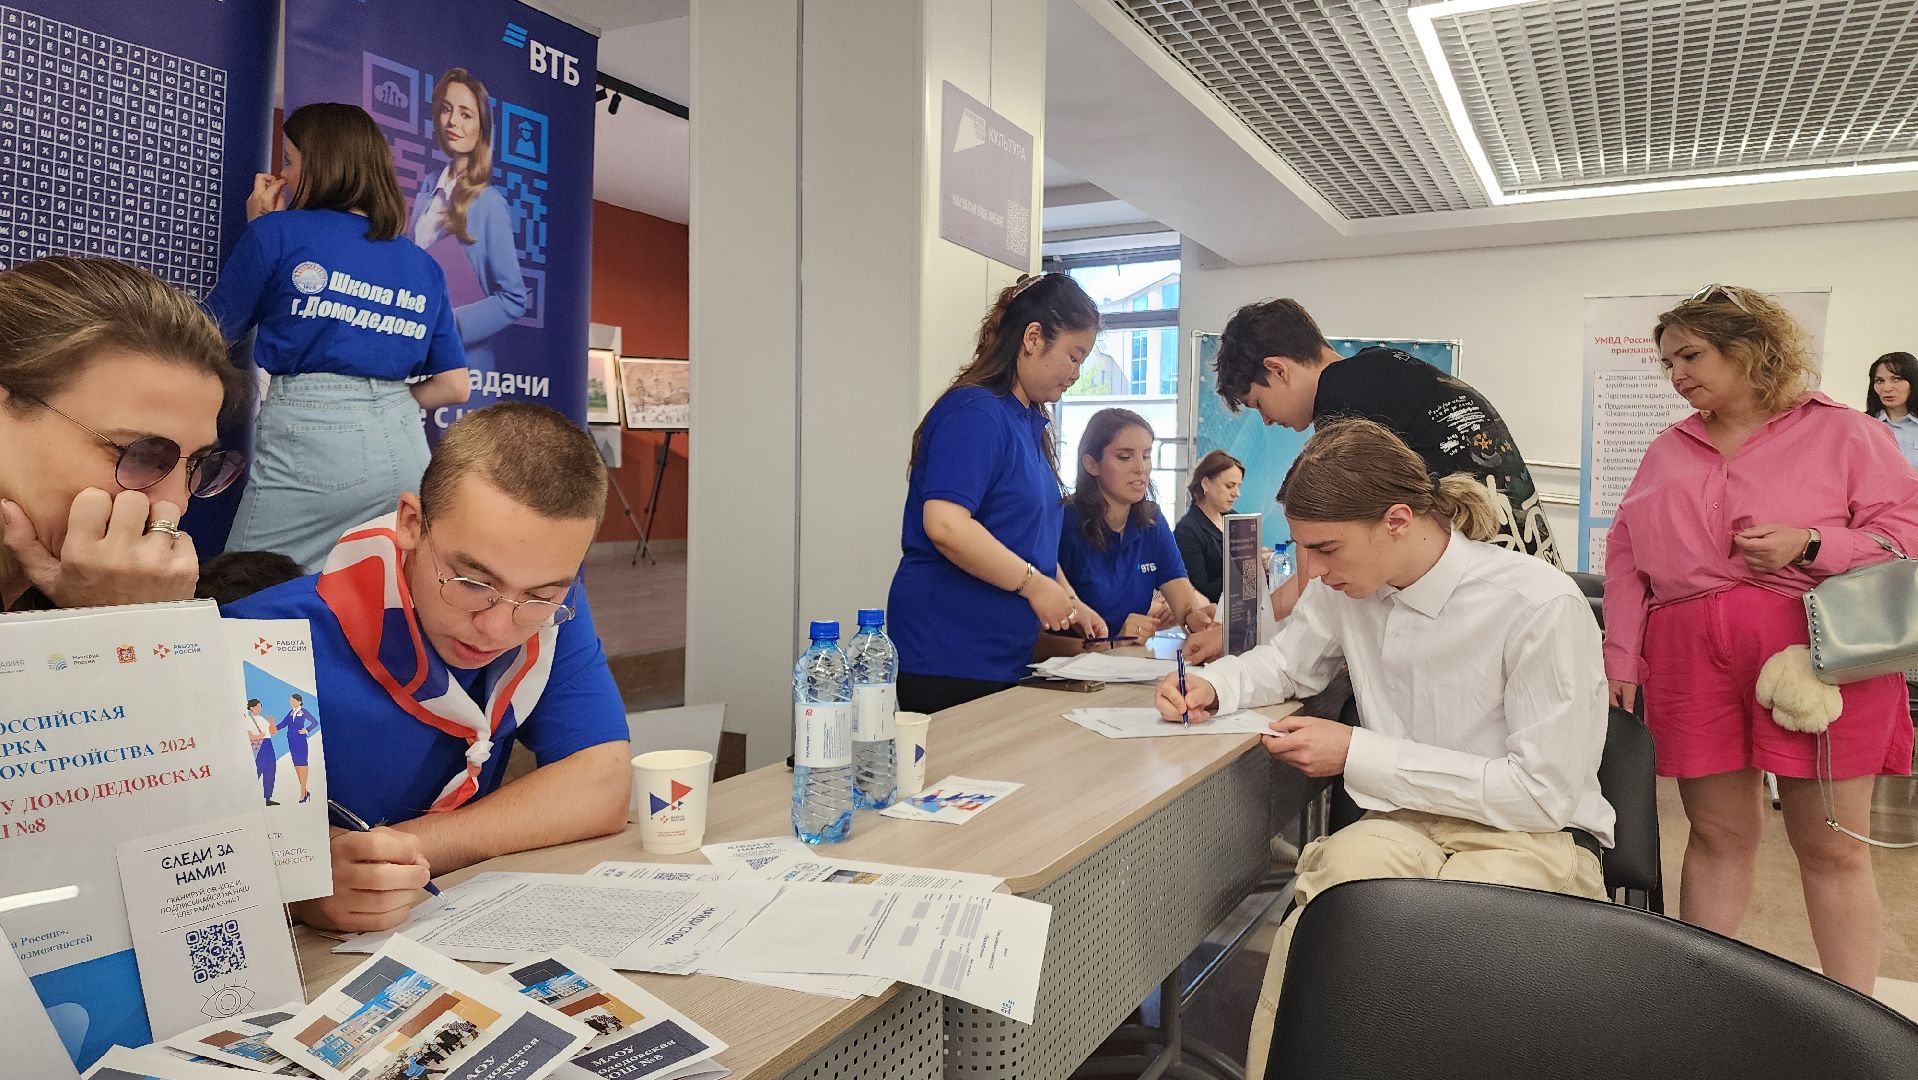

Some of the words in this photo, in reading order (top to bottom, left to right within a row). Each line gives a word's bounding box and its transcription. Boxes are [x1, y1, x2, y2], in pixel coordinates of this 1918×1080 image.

[530, 39, 580, 87] ВТБ
[988, 126, 1026, 161] КУЛЬТУРА
[328, 270, 394, 305] Школа
[395, 288, 427, 313] №8
[290, 295, 427, 340] г.Домодедово
[1594, 336, 1621, 345] УМВД
[468, 369, 549, 398] адачи
[159, 736, 197, 754] 2024
[23, 764, 212, 815] ДОМОДЕДОВСКАЯ
[15, 817, 46, 837] №8
[161, 846, 213, 870] СЛЕДИ
[216, 843, 235, 857] ЗА
[175, 862, 227, 886] НАМИ!
[20, 933, 93, 960] озможностей
[590, 1044, 634, 1068] МАОУ
[597, 1039, 677, 1075] одедовская
[637, 1054, 664, 1068] №8
